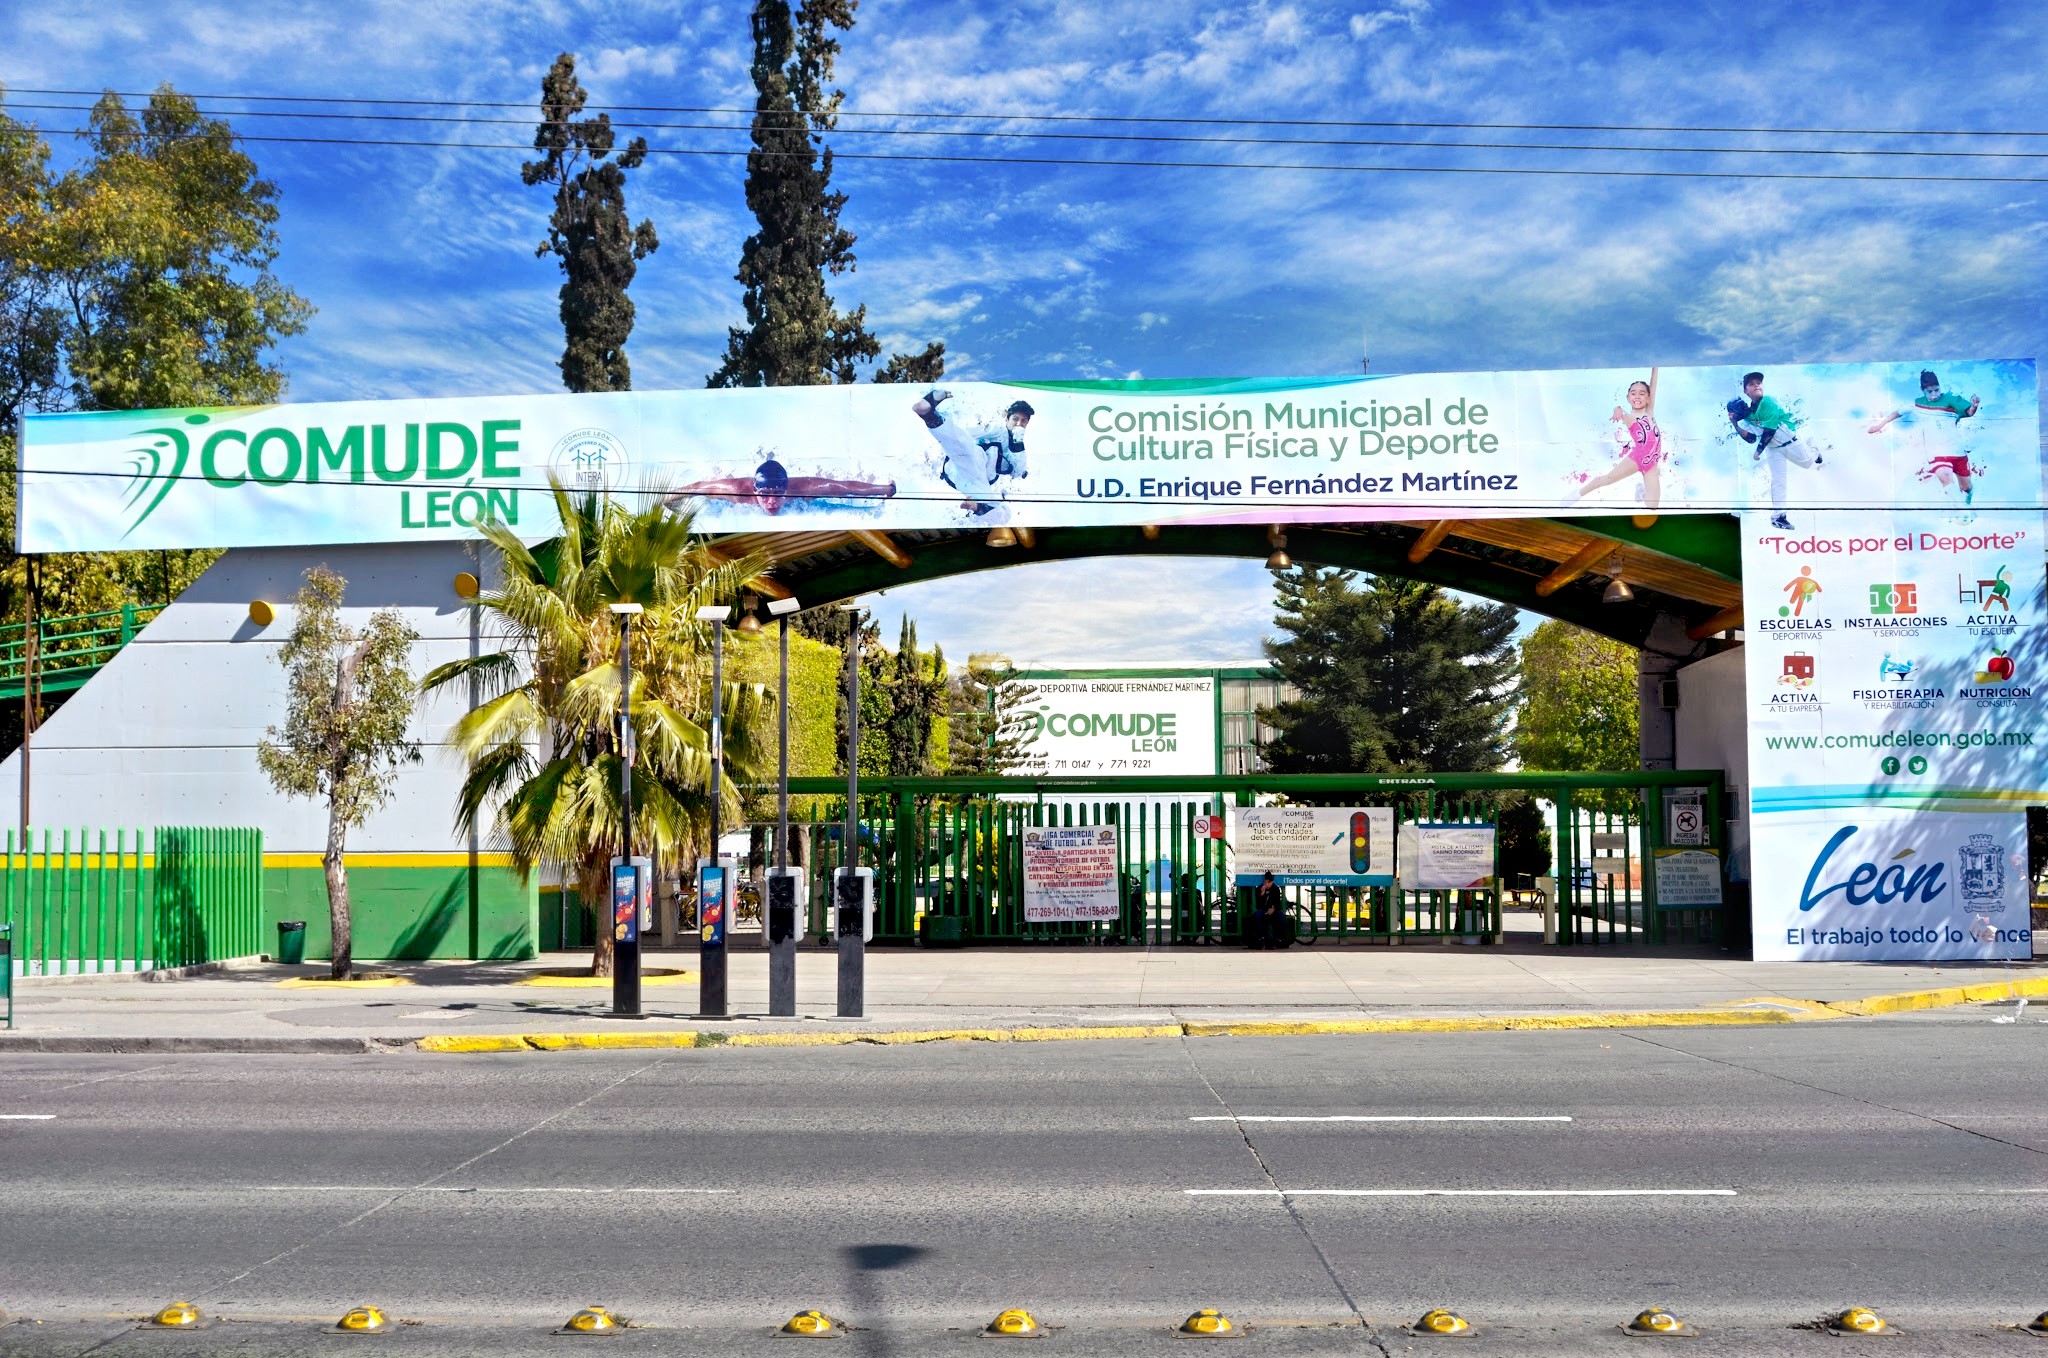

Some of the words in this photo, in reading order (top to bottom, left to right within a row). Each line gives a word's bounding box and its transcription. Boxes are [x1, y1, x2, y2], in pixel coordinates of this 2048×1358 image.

[1087, 400, 1252, 434] Comisión
[1265, 397, 1432, 434] Municipal
[1445, 397, 1489, 425] de
[1092, 433, 1214, 462] Cultura
[1225, 430, 1319, 459] Física
[1330, 437, 1348, 463] y
[1360, 429, 1499, 461] Deporte
[200, 419, 521, 488] COMUDE
[1076, 478, 1130, 498] U.D.
[1140, 476, 1242, 501] Enrique
[1251, 471, 1393, 496] Fernández
[1402, 469, 1518, 493] Martínez
[401, 477, 518, 529] LEÓN
[1849, 537, 1888, 556] por
[1894, 533, 1914, 551] el
[1760, 619, 1832, 630] ESCUELAS
[1844, 617, 1948, 629] INSTALACIONES
[1966, 615, 2018, 625] ACTIVA
[1773, 632, 1823, 641] DEPORTIVAS
[1873, 630, 1879, 638] Y
[1880, 629, 1920, 637] SERVICIOS
[1969, 628, 1979, 636] TU
[1981, 627, 2017, 636] ESCUELA
[1040, 683, 1088, 693] DEPORTIVA
[1092, 682, 1124, 693] ENRIQUE
[1175, 682, 1211, 692] MARTINEZ
[1960, 686, 2031, 698] NUTRICIÓN
[1771, 694, 1818, 703] ACTIVA
[1853, 689, 1945, 700] FISIOTERAPIA
[1770, 705, 1776, 713] A
[1777, 705, 1787, 713] TU
[1788, 704, 1823, 713] EMPRESA
[1864, 701, 1869, 710] Y
[1869, 700, 1935, 710] REHABILITACIÓN
[1976, 700, 2018, 708] CONSULTA
[1047, 713, 1176, 737] COMUDE
[1131, 736, 1176, 752] LEÓN
[1766, 731, 2034, 750] www.comudeleon.gob.mx
[1055, 760, 1067, 769] 711
[1072, 760, 1091, 769] 0147
[1111, 760, 1127, 769] 771
[1132, 759, 1151, 769] 9221
[1247, 821, 1271, 829] Antes
[1273, 821, 1282, 829] de
[1285, 821, 1315, 829] realizar
[1044, 831, 1058, 839] LIGA
[1060, 830, 1095, 839] COMERCIAL
[1799, 825, 1947, 912] León
[1305, 877, 1315, 885] por
[1787, 928, 1805, 945] El
[1812, 926, 1883, 947] trabajo
[1890, 927, 1938, 945] todo
[1945, 926, 1963, 944] lo
